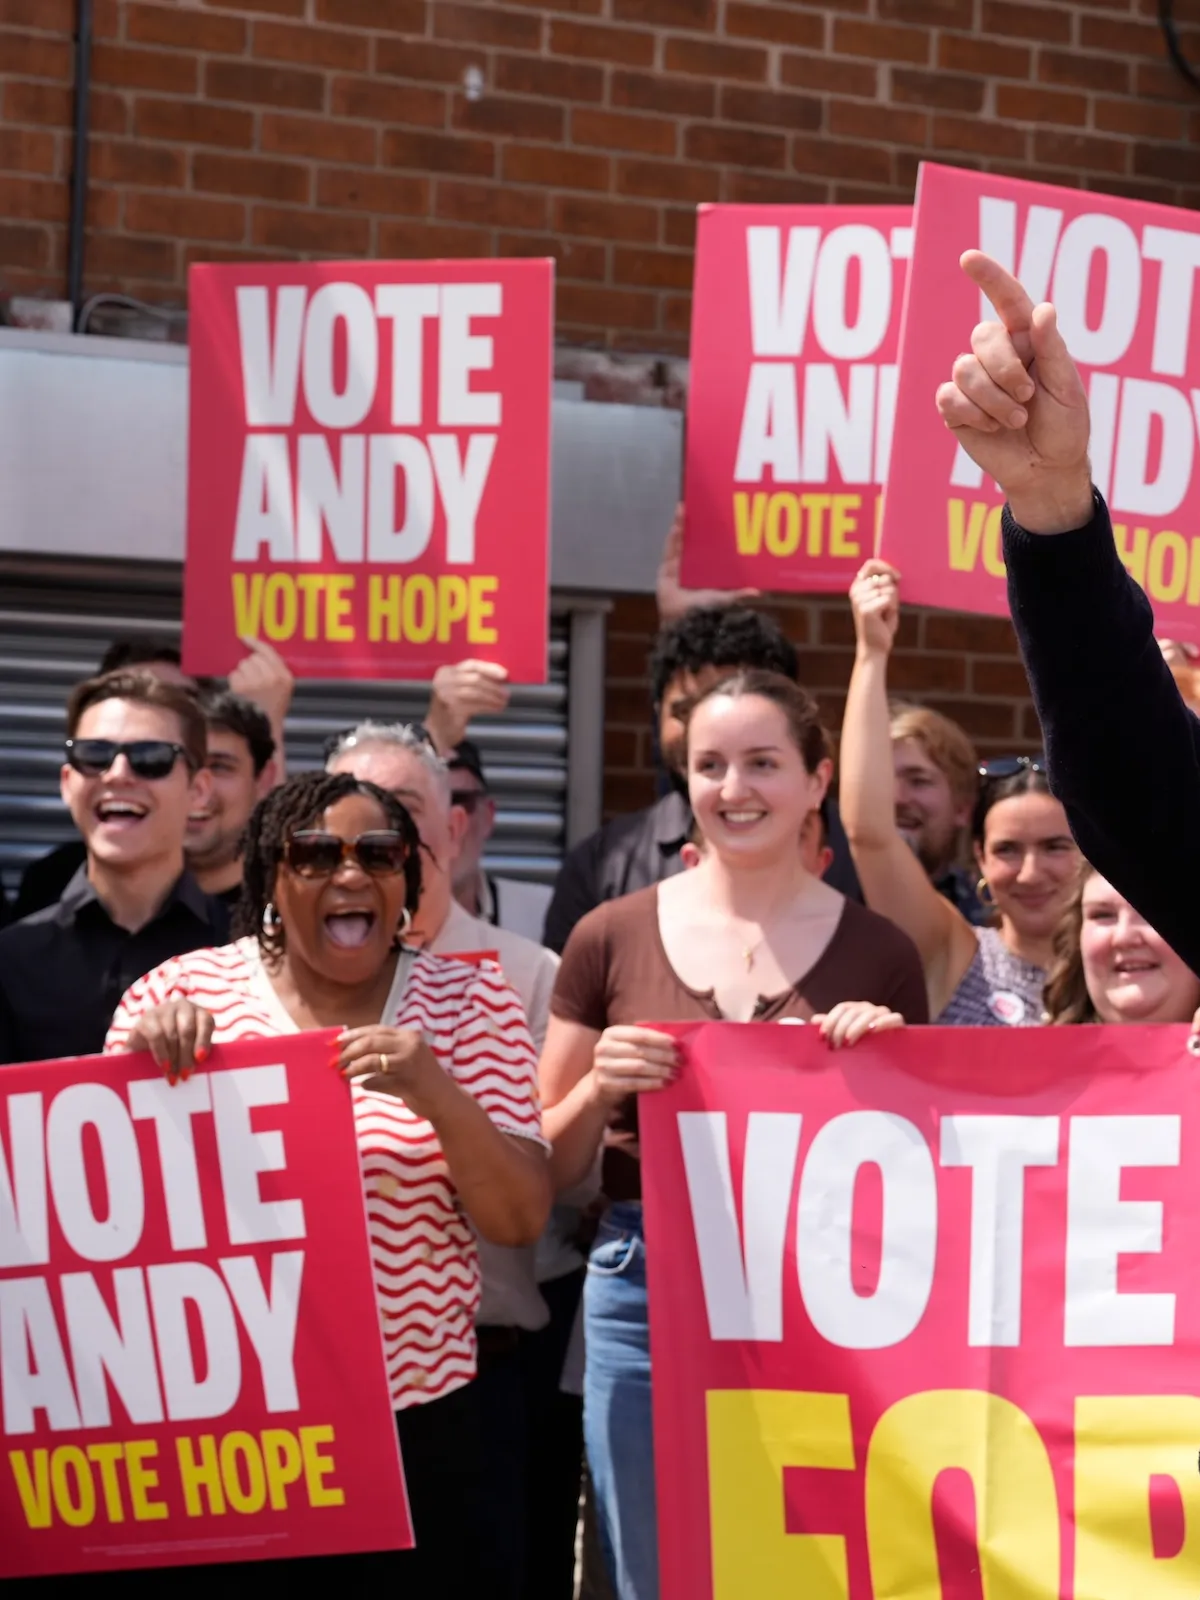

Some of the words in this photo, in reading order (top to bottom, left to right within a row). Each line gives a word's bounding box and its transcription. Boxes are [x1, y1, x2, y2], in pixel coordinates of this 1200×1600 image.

[236, 282, 502, 429] VOTE
[746, 223, 915, 360] VO
[734, 362, 899, 485] AN
[231, 433, 498, 564] ANDY
[732, 491, 861, 558] VOTE
[231, 573, 355, 642] VOTE
[368, 575, 498, 644] HOPE
[676, 1110, 1181, 1350] VOTE
[0, 1250, 305, 1435] ANDY
[8, 1439, 168, 1529] VOTE
[176, 1424, 345, 1518] HOPE
